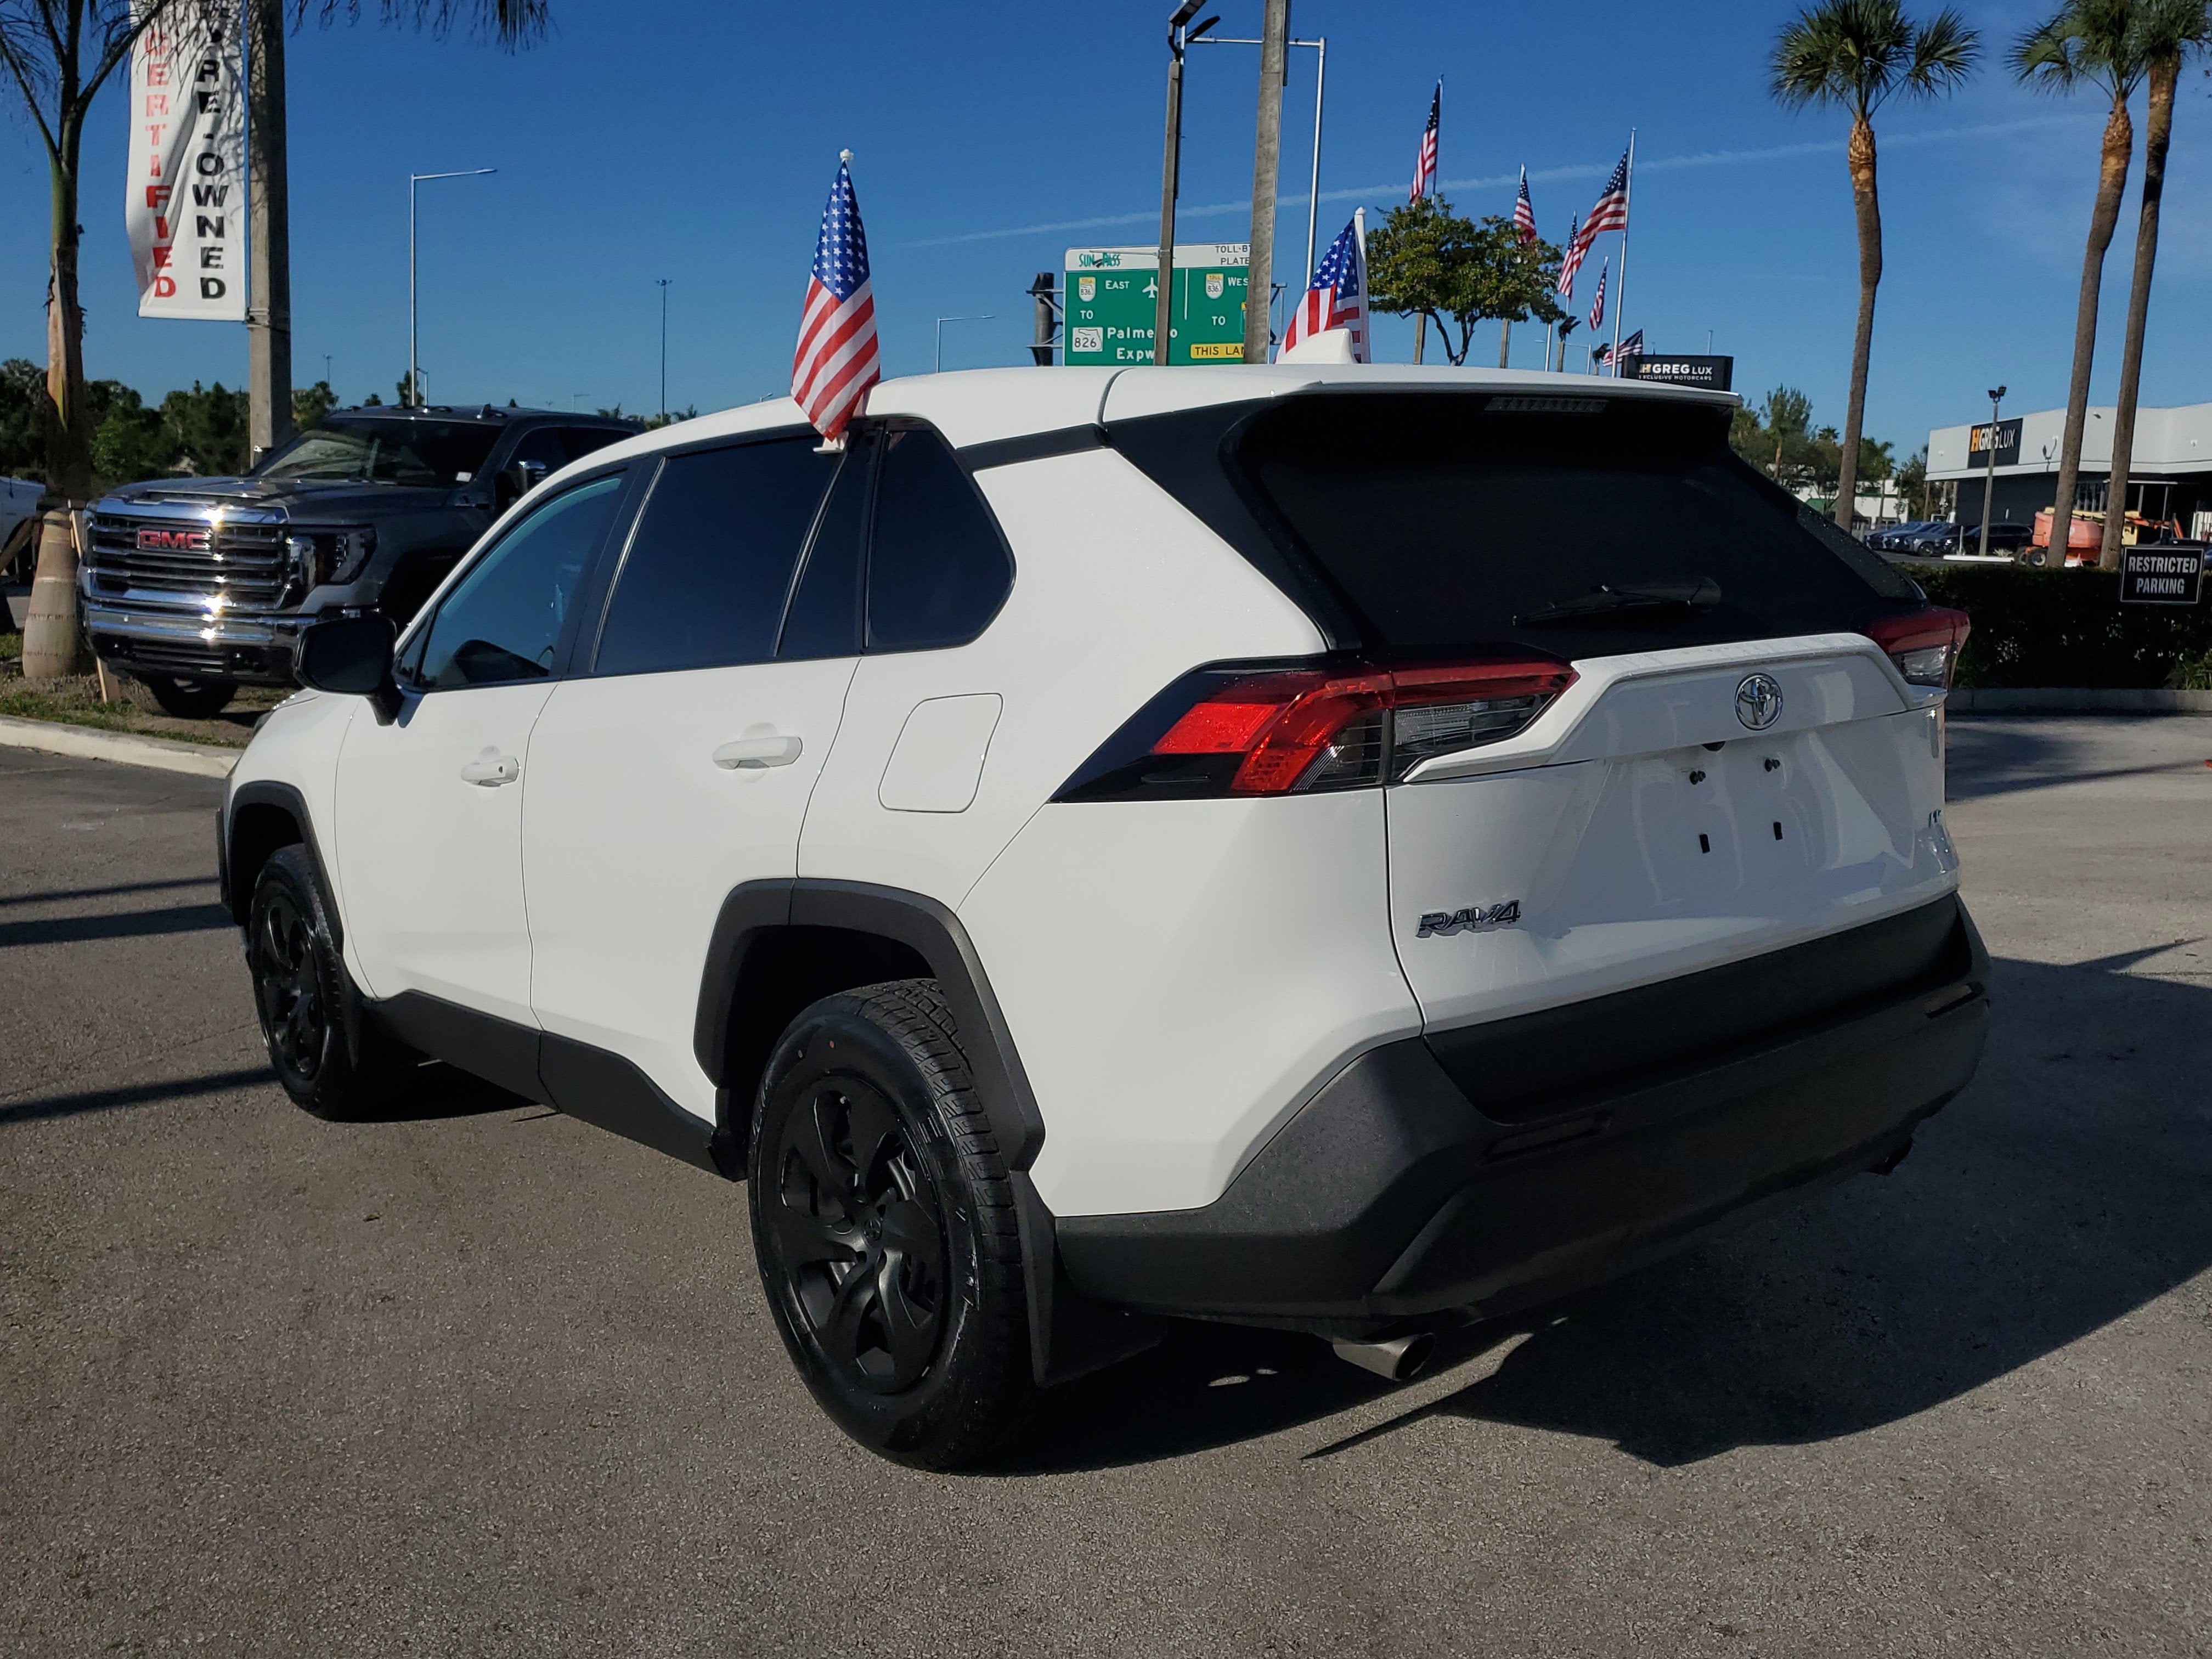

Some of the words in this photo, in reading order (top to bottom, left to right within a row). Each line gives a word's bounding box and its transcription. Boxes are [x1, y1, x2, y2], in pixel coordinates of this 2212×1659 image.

[144, 32, 176, 299] CERTIFIED
[1215, 245, 1251, 253] TOLL-B
[1105, 280, 1130, 289] EAST
[1228, 276, 1249, 286] WES
[1080, 310, 1094, 319] TO
[1211, 316, 1226, 326] TO
[1107, 327, 1178, 339] Palmeo
[1074, 337, 1097, 348] 826
[1116, 347, 1155, 362] Expw
[1195, 346, 1219, 356] THIS
[1226, 346, 1244, 356] LA
[1692, 366, 1713, 375] LUX
[138, 530, 212, 549] GMC
[2128, 556, 2198, 573] RESTRICTED
[2136, 577, 2185, 594] PARKING
[1416, 899, 1521, 933] RAV4
